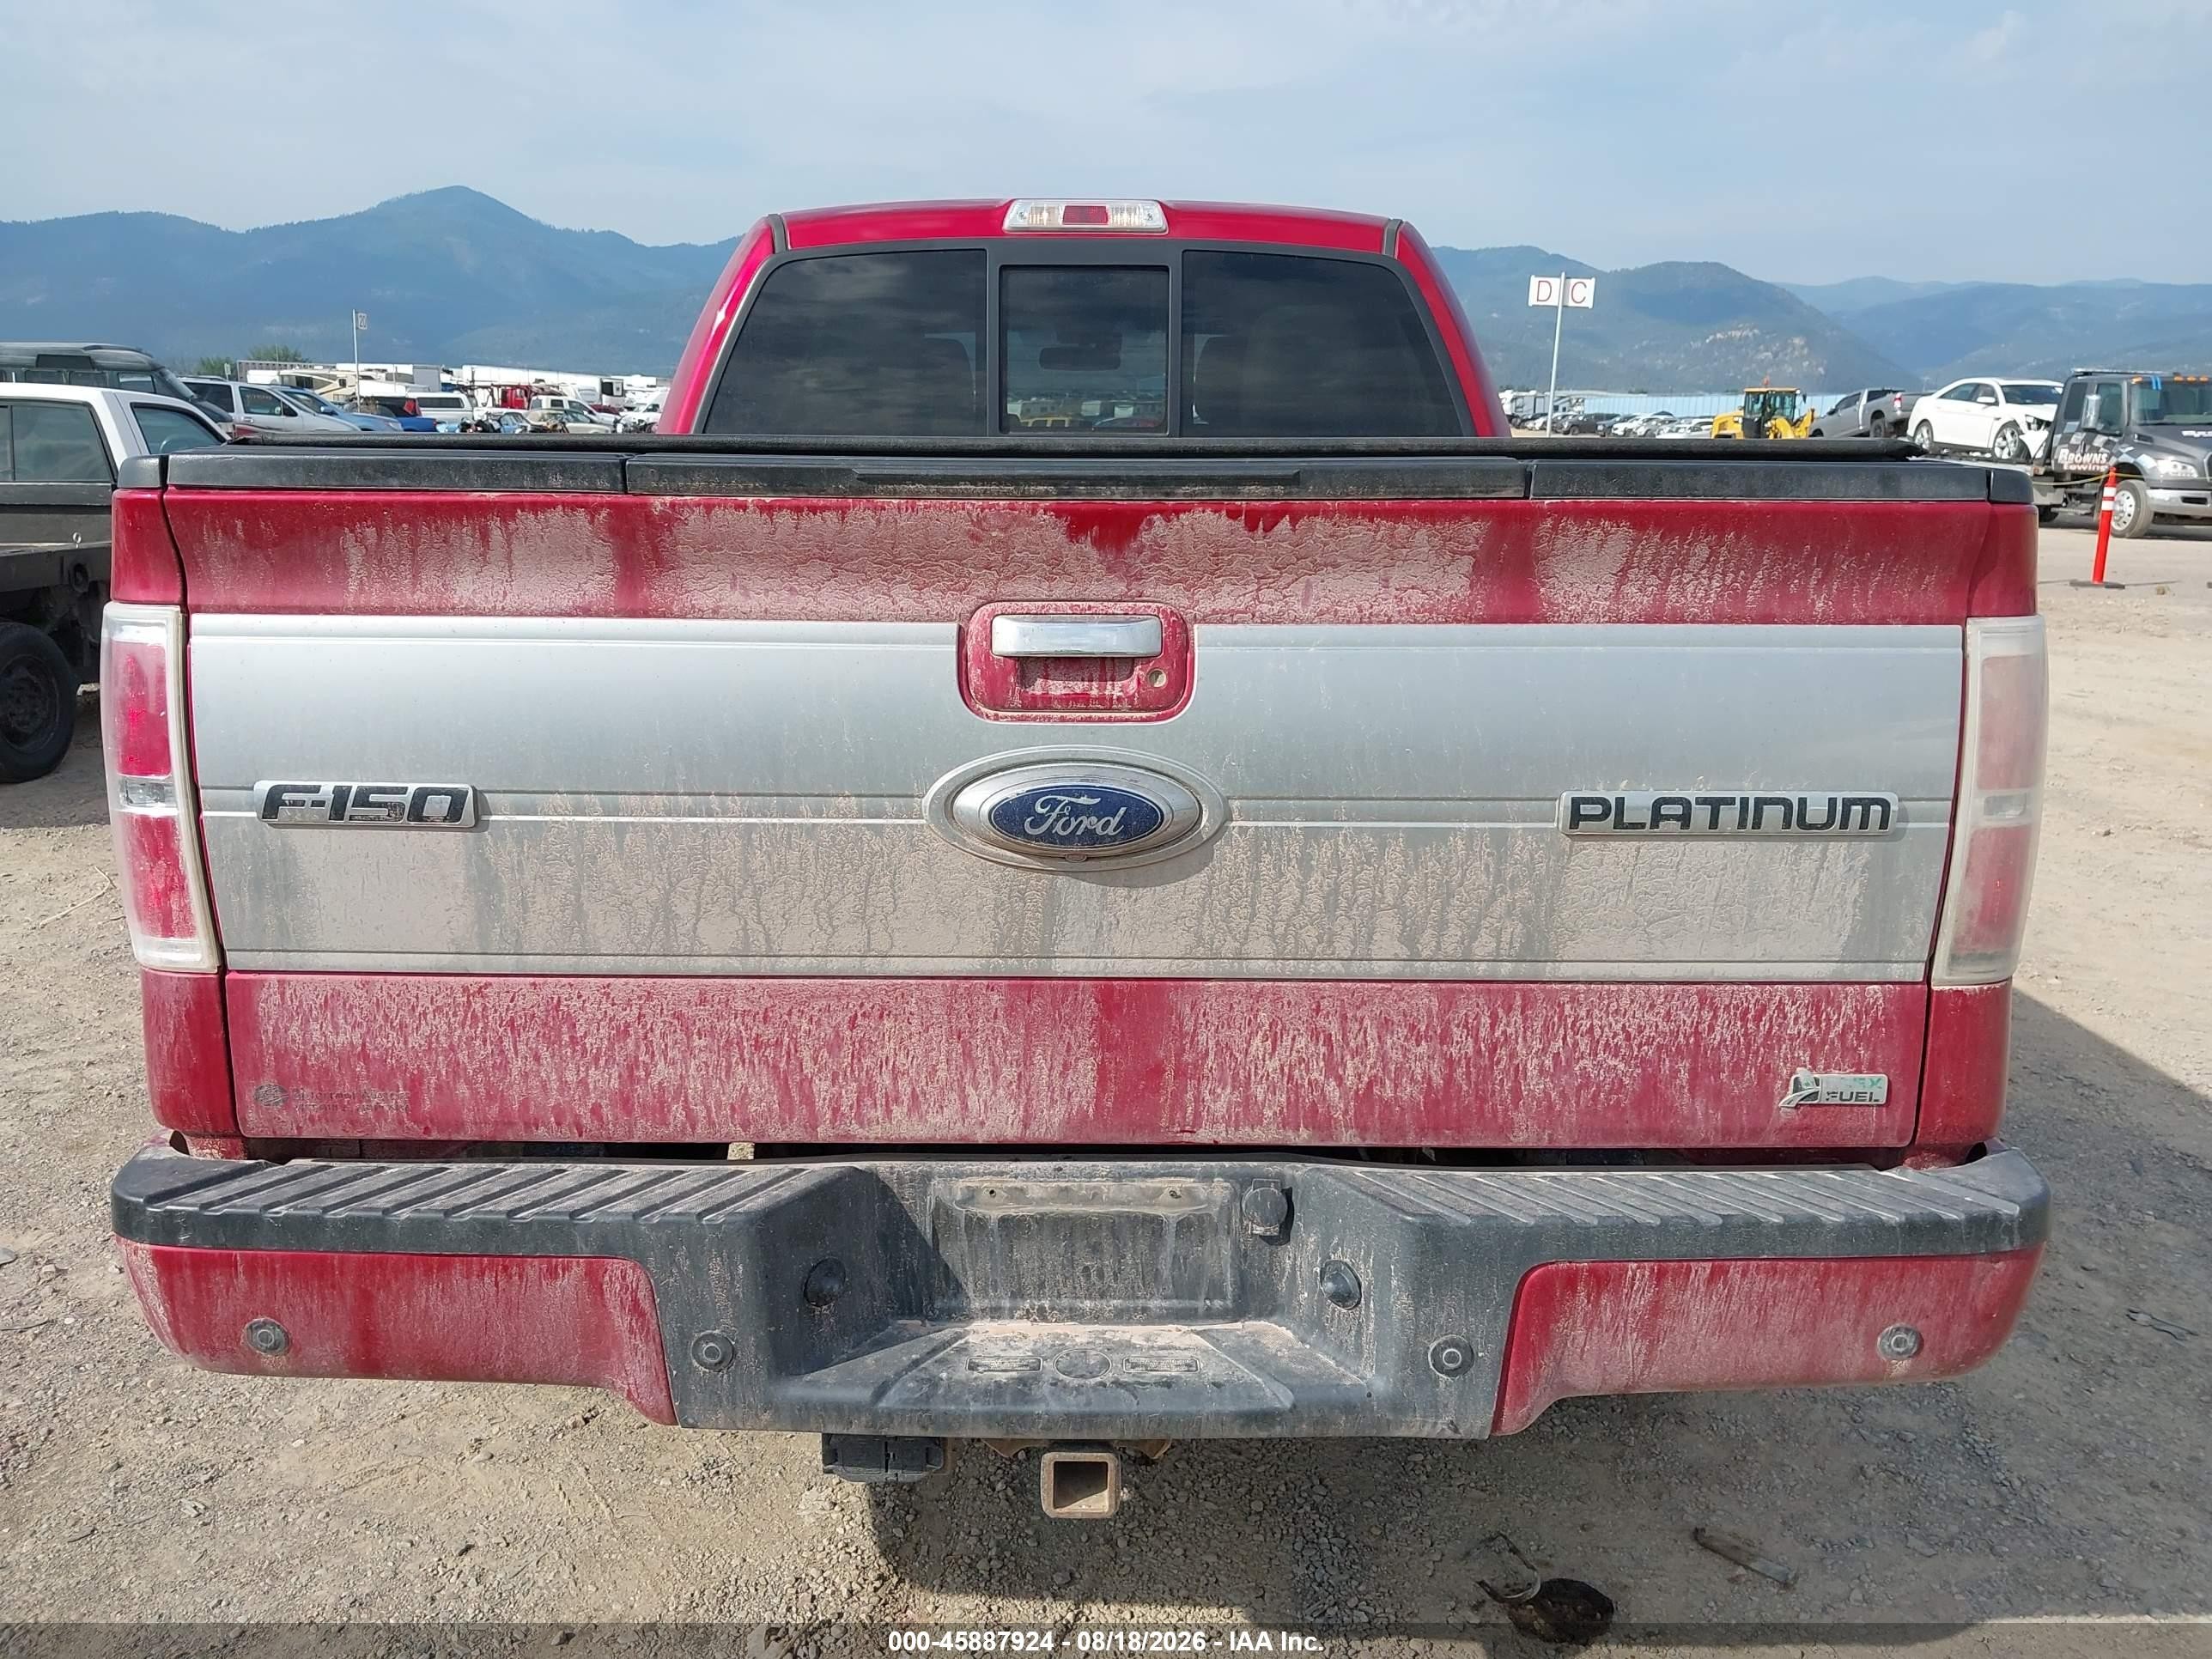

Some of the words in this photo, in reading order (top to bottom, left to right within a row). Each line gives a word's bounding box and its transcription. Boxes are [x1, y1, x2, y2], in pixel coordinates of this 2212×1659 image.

[1536, 280, 1553, 302] D
[1571, 281, 1588, 304] C
[261, 783, 471, 823] F-150
[1023, 793, 1128, 838] Ford
[1568, 795, 1891, 831] PLATINUM
